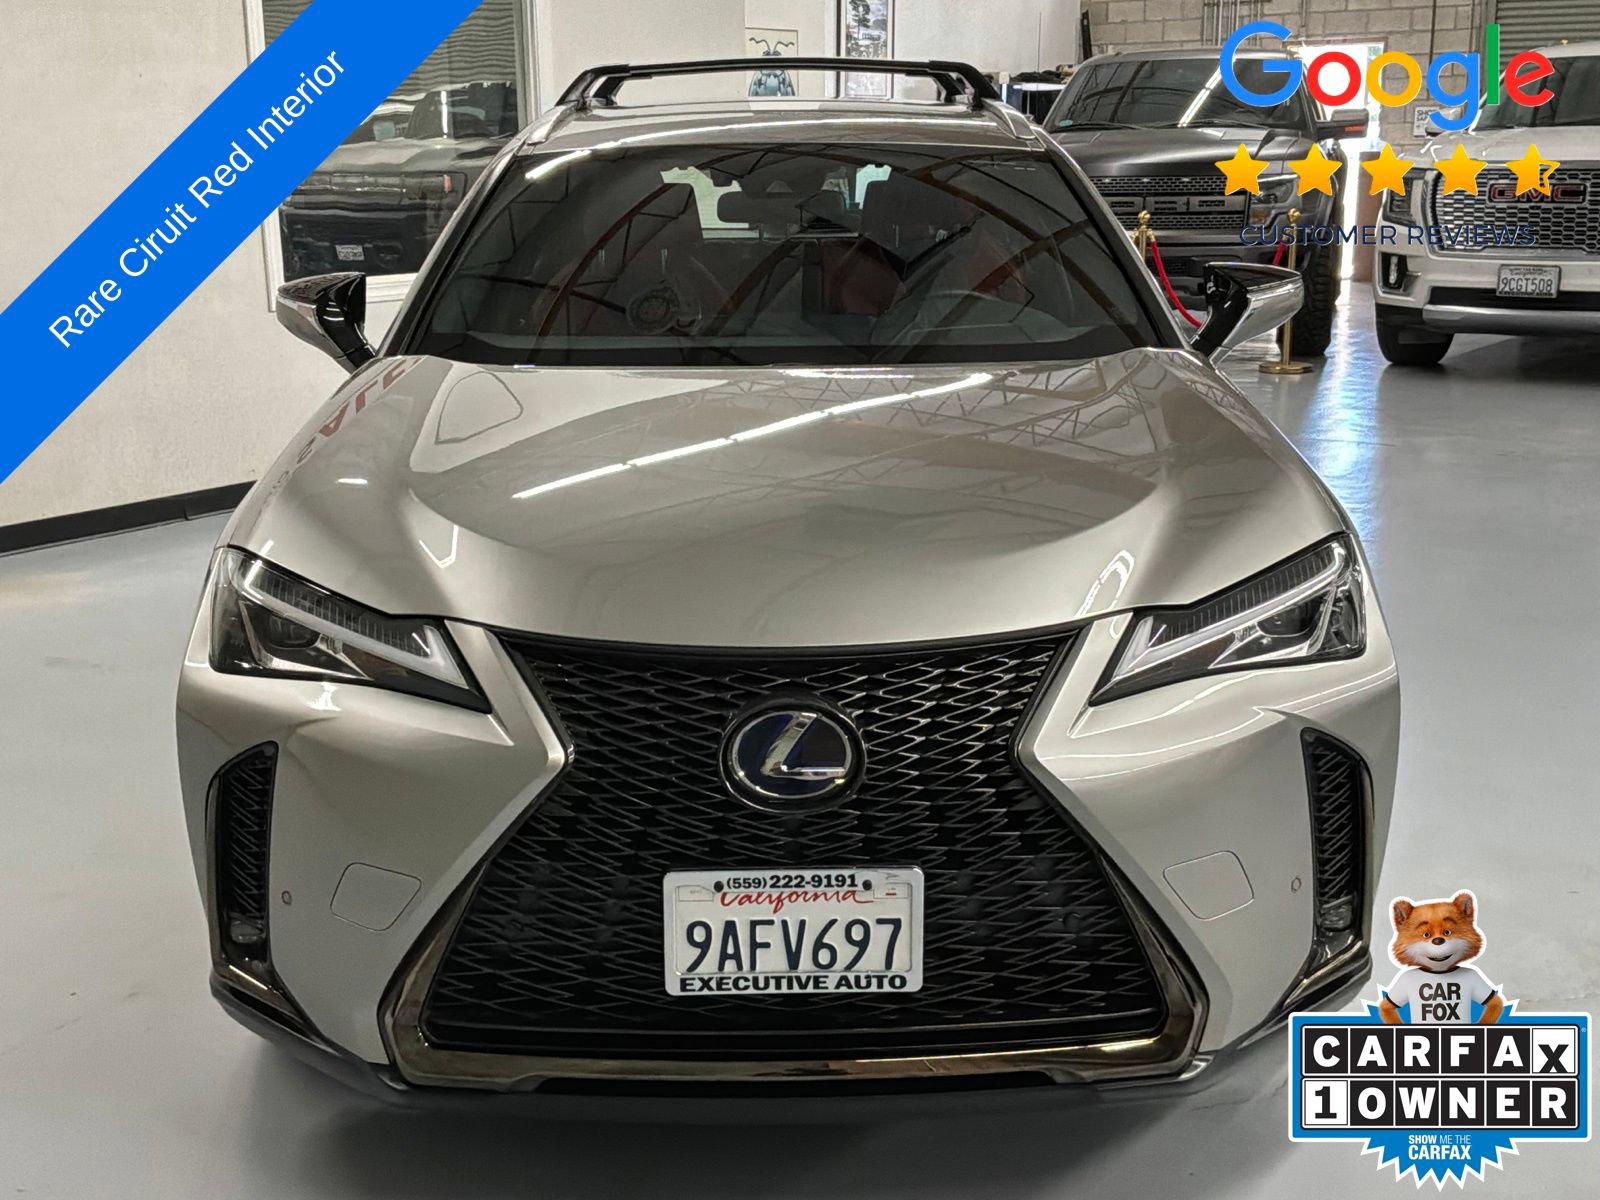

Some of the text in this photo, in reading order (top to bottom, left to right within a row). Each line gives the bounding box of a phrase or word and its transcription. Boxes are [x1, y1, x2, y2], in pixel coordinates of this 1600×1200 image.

[1501, 277, 1553, 293] 9CGT508
[726, 874, 858, 889] (559) 222-9191
[720, 890, 874, 914] California
[686, 918, 903, 973] 9AFV697
[679, 974, 908, 993] EXECUTIVE AUTO
